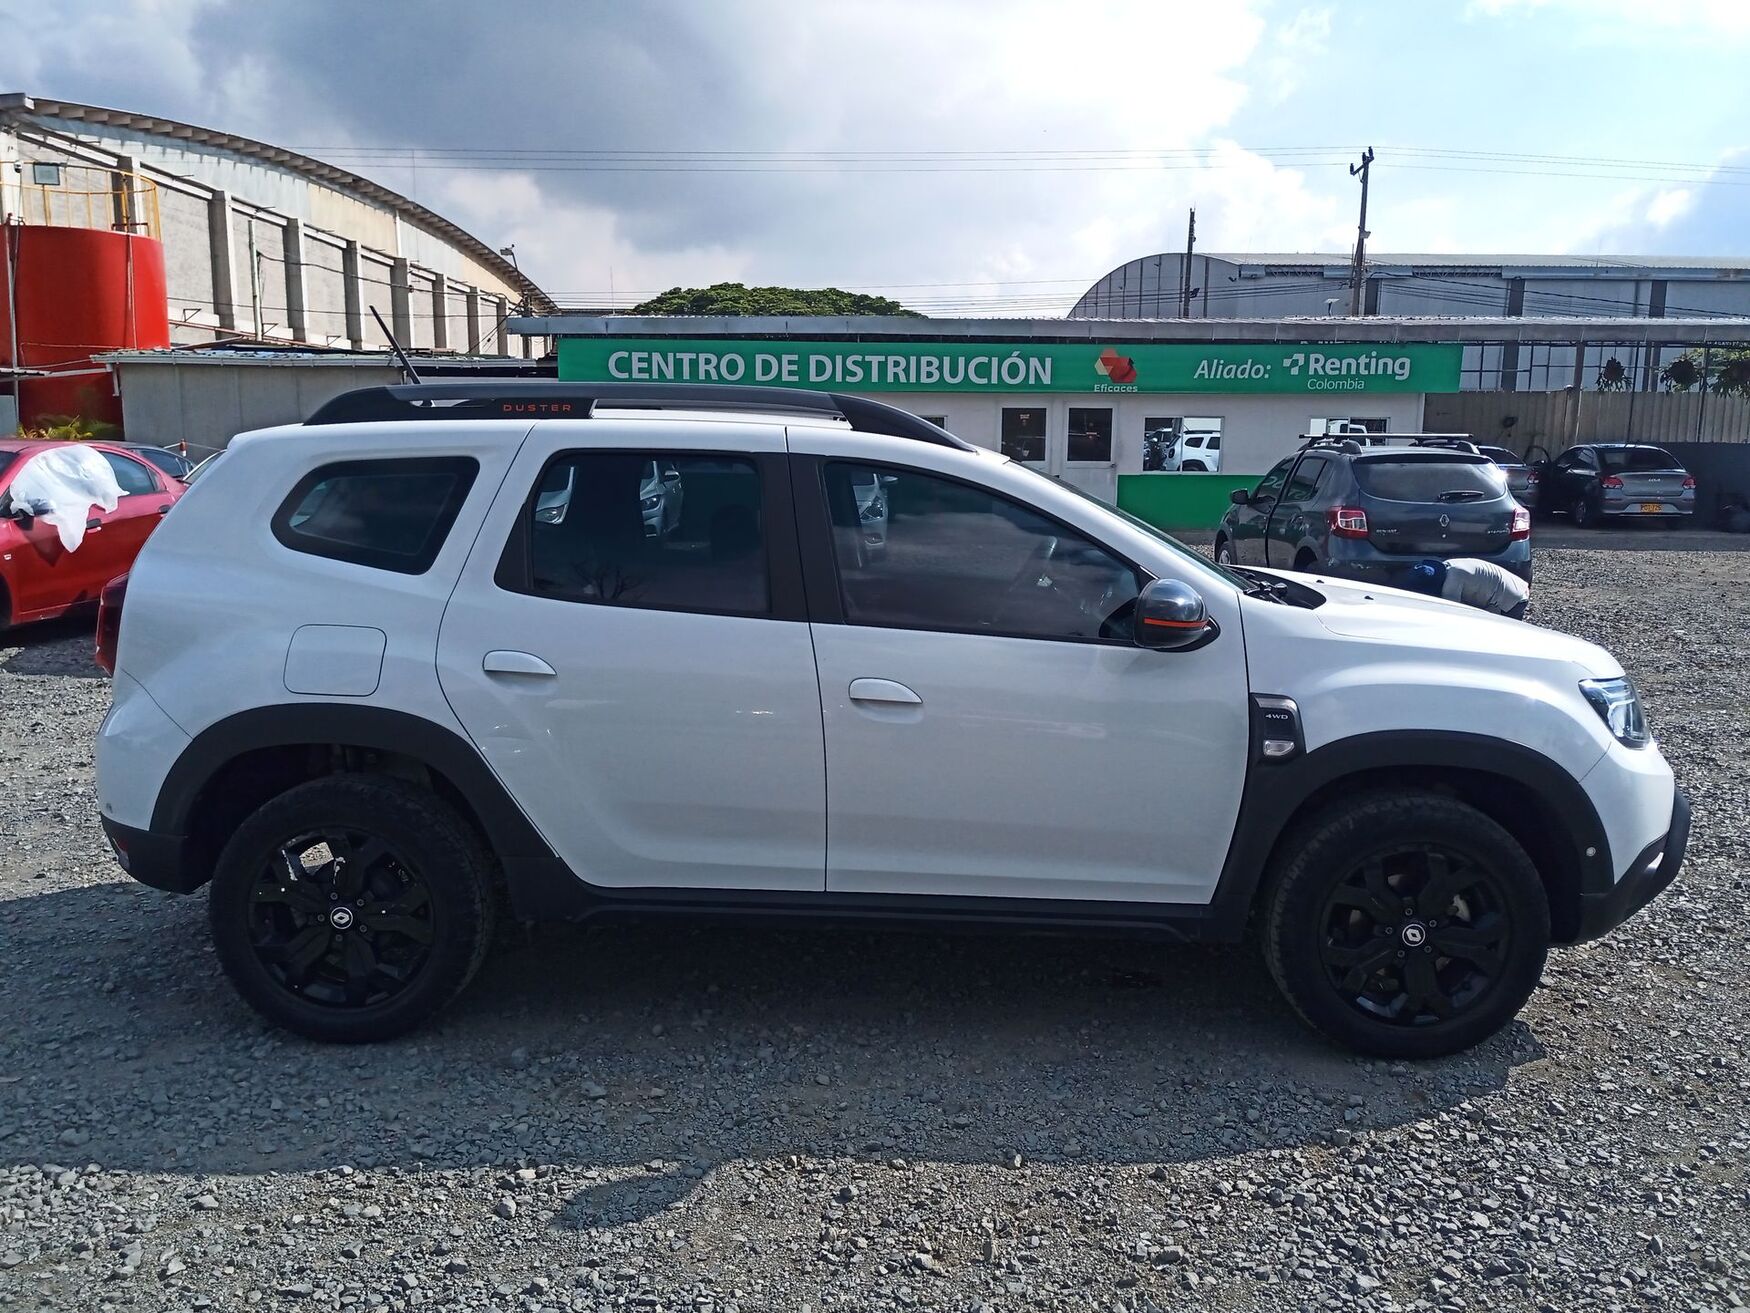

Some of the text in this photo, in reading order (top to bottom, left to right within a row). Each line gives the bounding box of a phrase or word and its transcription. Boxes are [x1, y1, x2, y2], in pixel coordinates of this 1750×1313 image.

[608, 350, 1052, 385] CENTRO DE DISTRIBUCIÓN
[1193, 358, 1272, 379] Aliado:
[1308, 350, 1411, 381] Renting
[1094, 383, 1138, 393] Eficaces
[1307, 378, 1365, 390] Colombia
[503, 404, 571, 412] DUSTER
